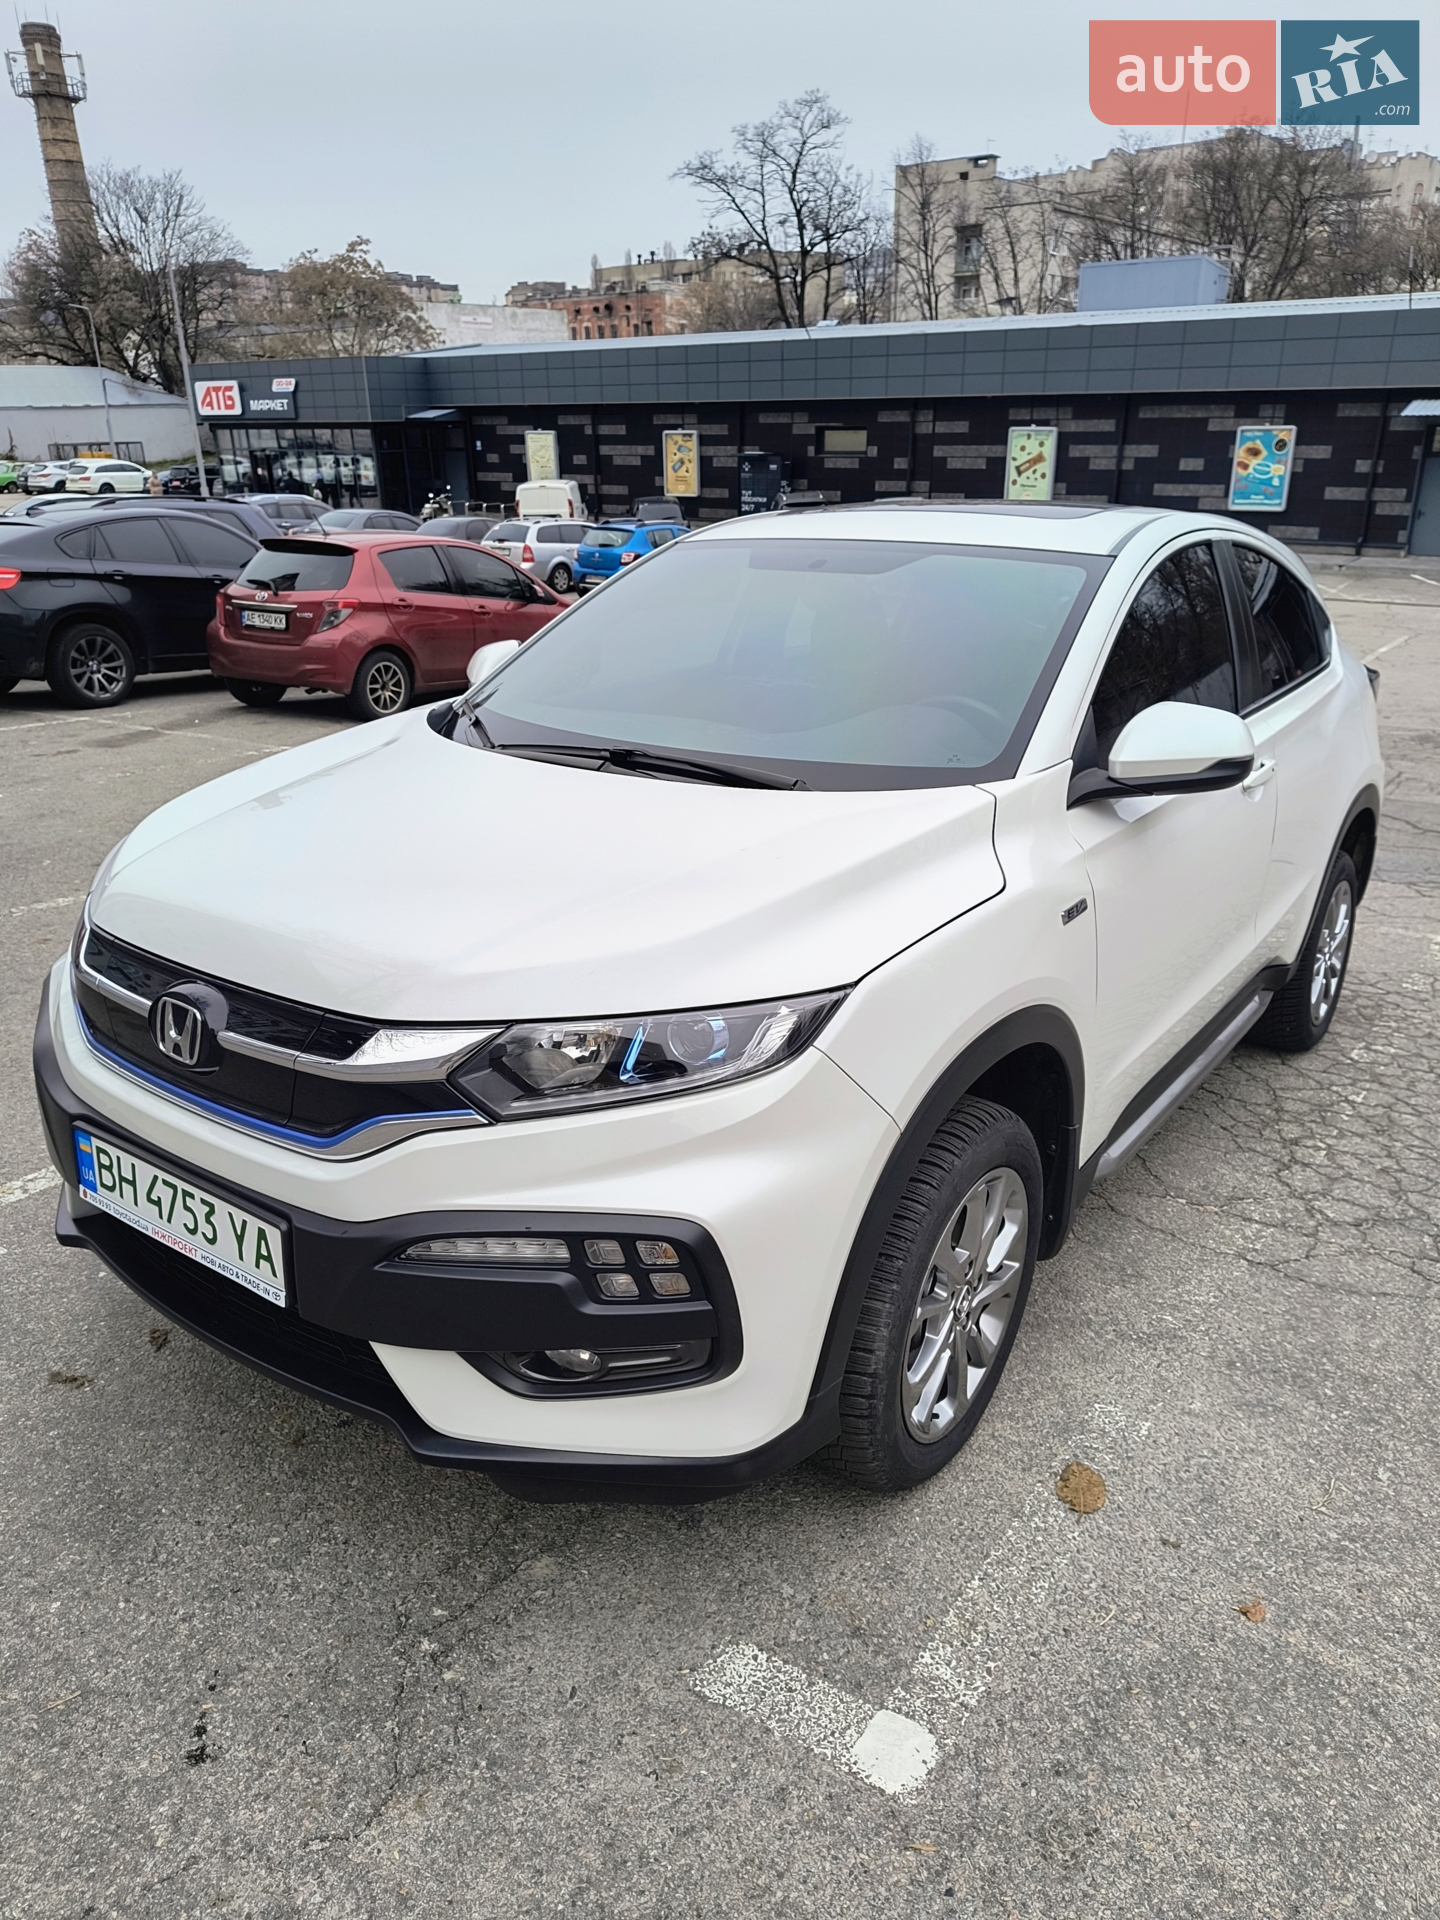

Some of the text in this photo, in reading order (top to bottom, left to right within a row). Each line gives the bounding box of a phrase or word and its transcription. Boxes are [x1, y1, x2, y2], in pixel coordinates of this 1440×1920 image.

[201, 386, 235, 410] АТБ
[250, 399, 289, 411] МАРКЕТ
[246, 613, 285, 627] AE 1340 KK
[82, 1166, 95, 1183] UA
[95, 1144, 279, 1279] BH 4753 YA
[200, 1253, 217, 1268] НОВІ
[217, 1262, 235, 1277] АВТО
[234, 1270, 241, 1280] &
[241, 1274, 271, 1297] TRADE-IN
